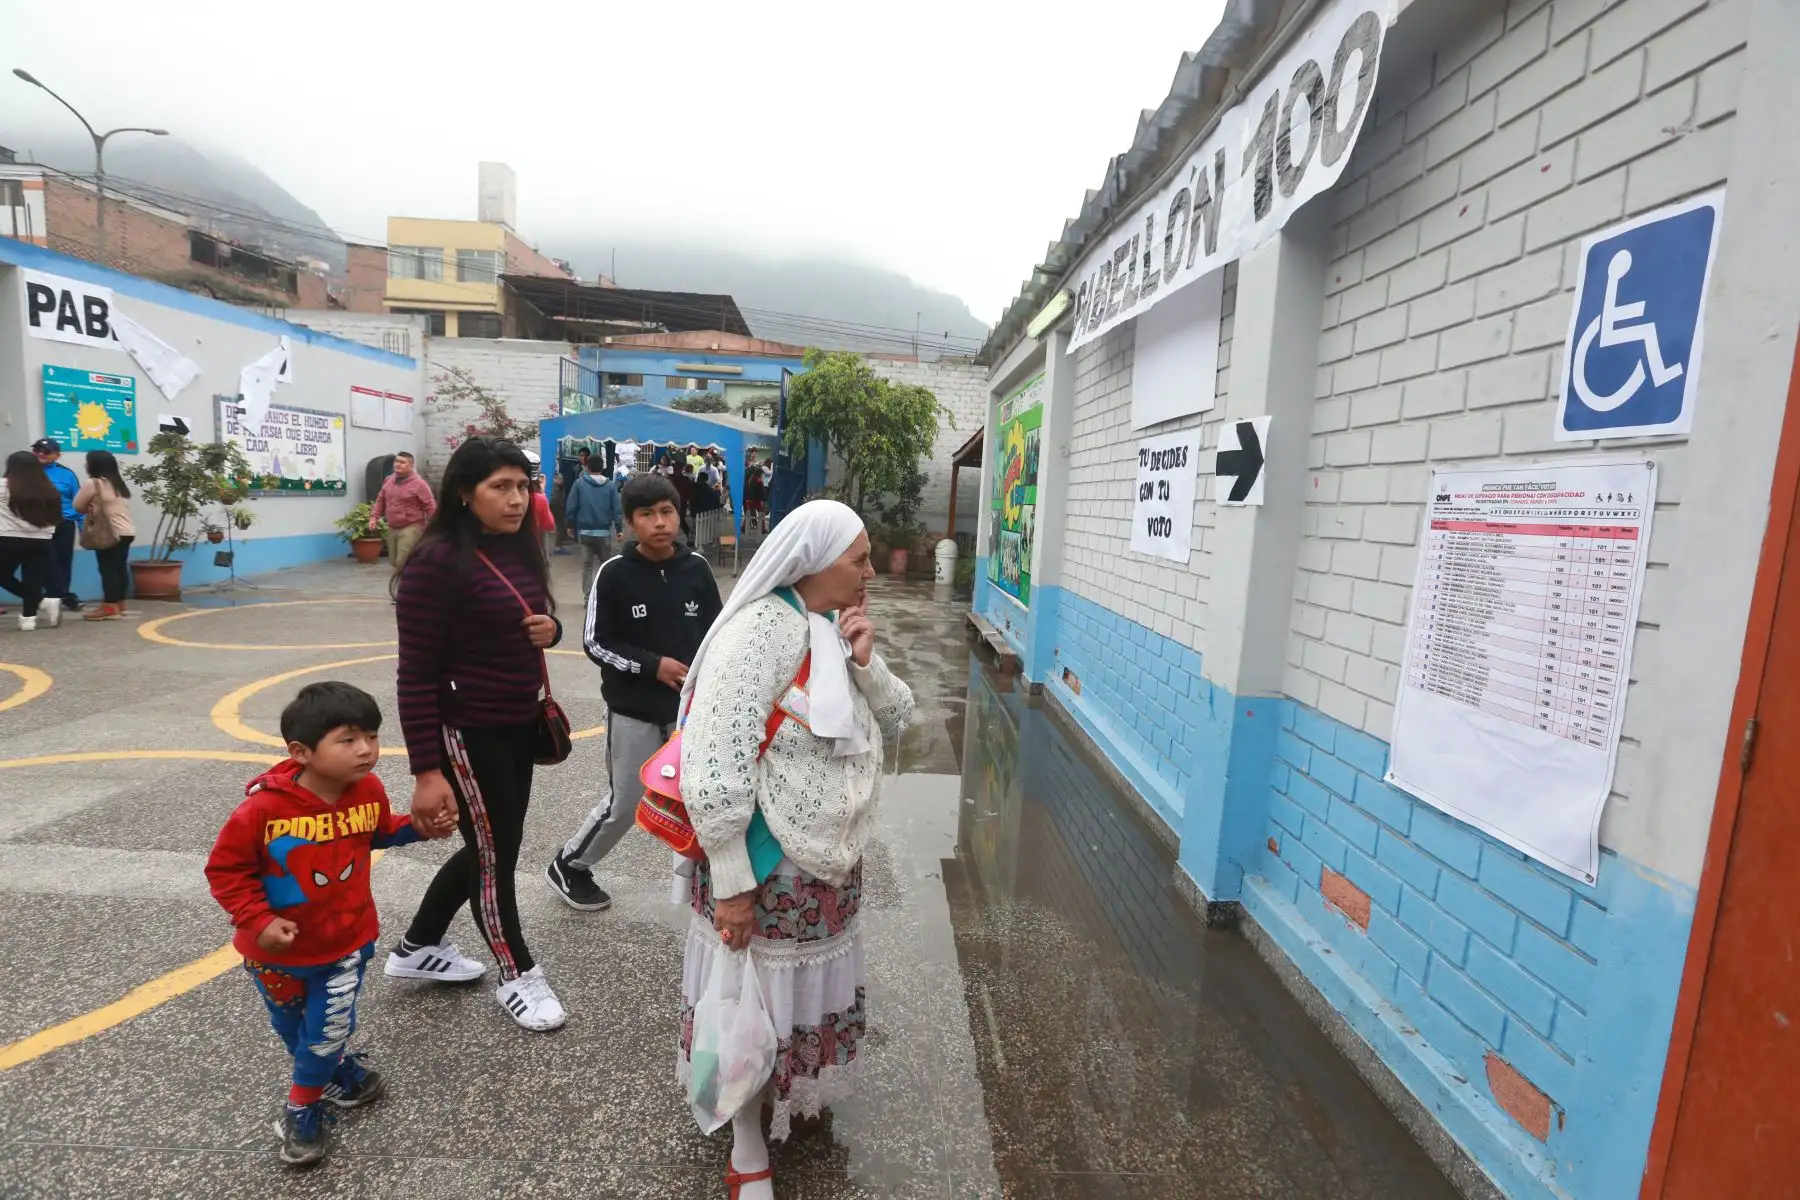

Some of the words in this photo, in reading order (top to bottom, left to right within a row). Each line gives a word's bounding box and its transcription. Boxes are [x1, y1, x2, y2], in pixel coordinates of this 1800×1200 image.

[1240, 10, 1380, 224] 100
[26, 281, 119, 342] PAB
[227, 421, 239, 435] DE
[286, 428, 301, 441] QUE
[292, 414, 302, 426] EL
[246, 439, 270, 452] CADA
[296, 443, 317, 456] LIBRO
[1139, 448, 1149, 468] TU
[1150, 445, 1188, 471] DECIDES
[1140, 481, 1154, 502] CON
[1158, 480, 1169, 501] TU
[1148, 516, 1171, 538] VOTO
[632, 604, 647, 618] 03
